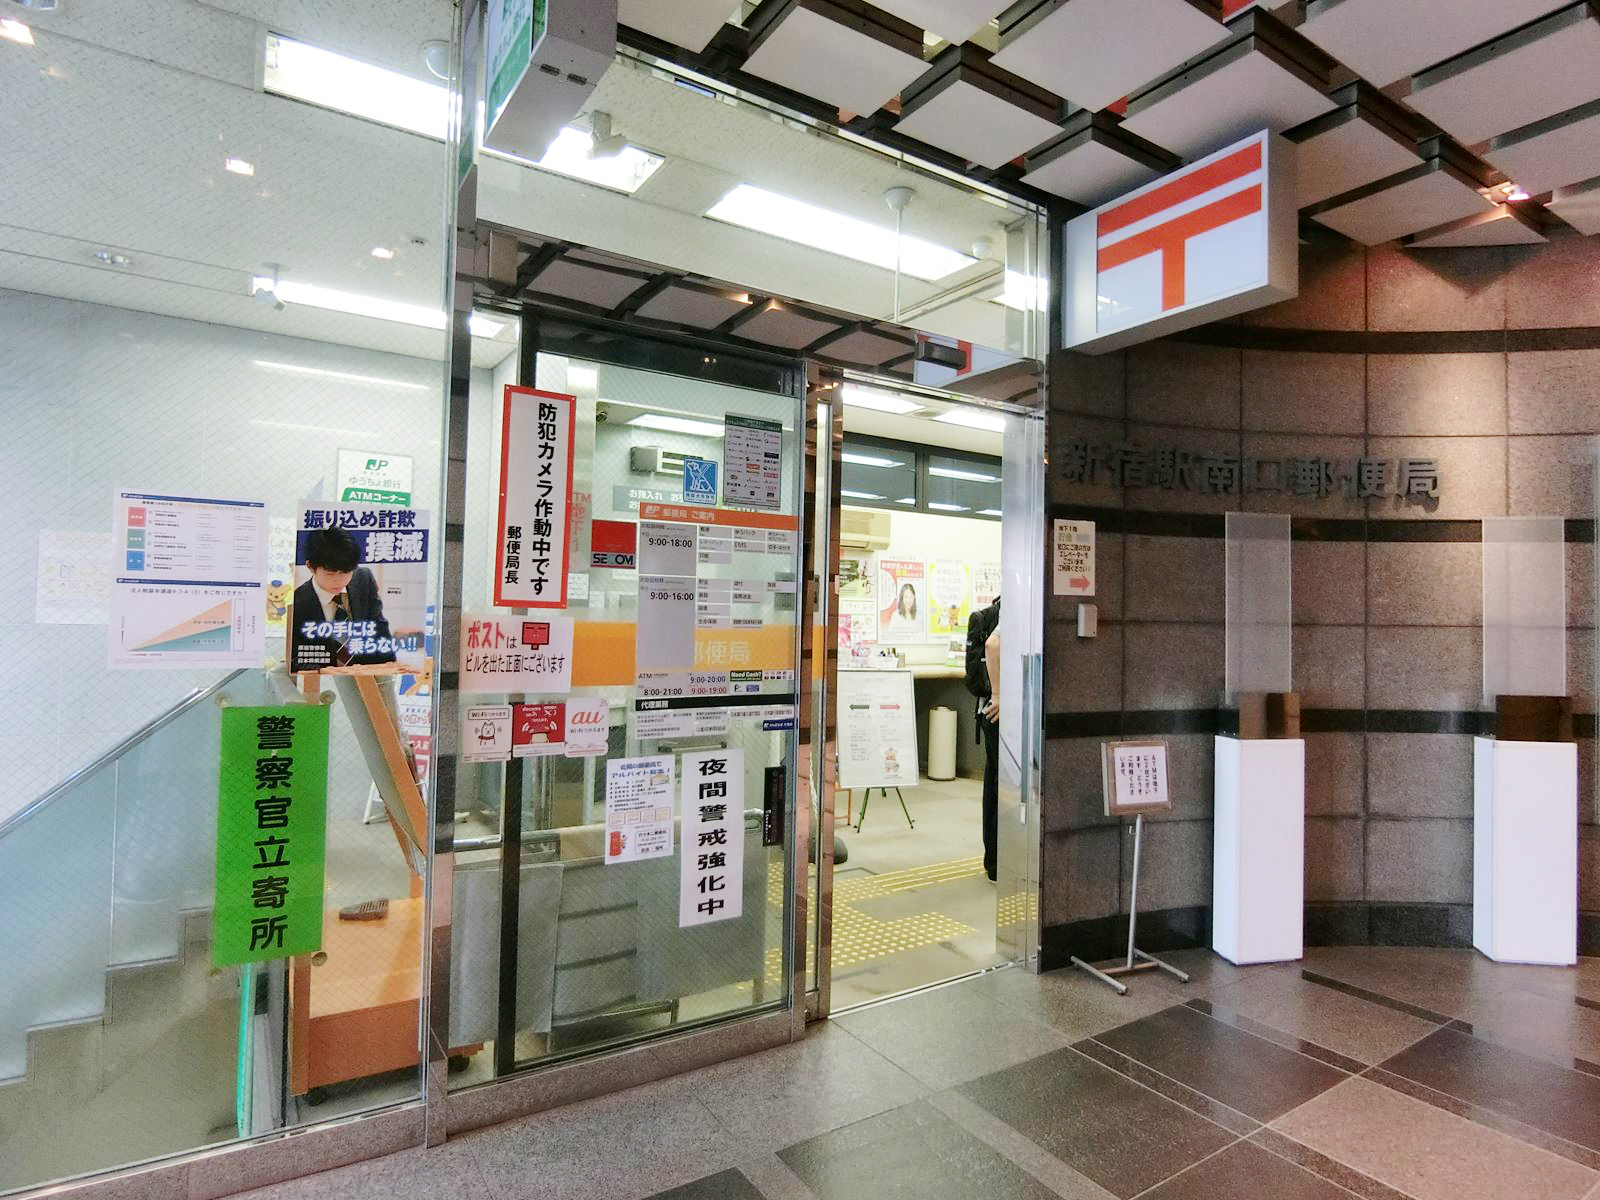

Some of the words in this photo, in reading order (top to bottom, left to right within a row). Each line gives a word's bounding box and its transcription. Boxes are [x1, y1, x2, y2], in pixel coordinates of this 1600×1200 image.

[1060, 440, 1441, 502] 新宿駅南口郵便局
[349, 476, 402, 489] ゆうちょ銀行
[349, 490, 406, 503] ATMコーナー
[531, 402, 557, 595] 防犯カメラ作動中です
[304, 509, 417, 529] 振り込め詐欺
[691, 510, 716, 522] ご案内
[365, 531, 424, 563] 撲滅
[648, 537, 693, 548] 9:00-18:00
[505, 525, 522, 584] 郵便局長
[592, 553, 634, 566] SEOM
[650, 591, 695, 601] 9:00-16:00
[301, 621, 377, 639] その手には
[467, 620, 518, 649] ポストは
[348, 636, 417, 654] 乗らない!!
[465, 653, 566, 674] ビルを出た正面にございます
[643, 688, 683, 696] 8:00-21:00
[691, 687, 728, 695] 9:00-19:00
[571, 711, 605, 724] au
[249, 715, 296, 951] 警察官立寄所
[697, 758, 728, 915] 夜間警戒強化中
